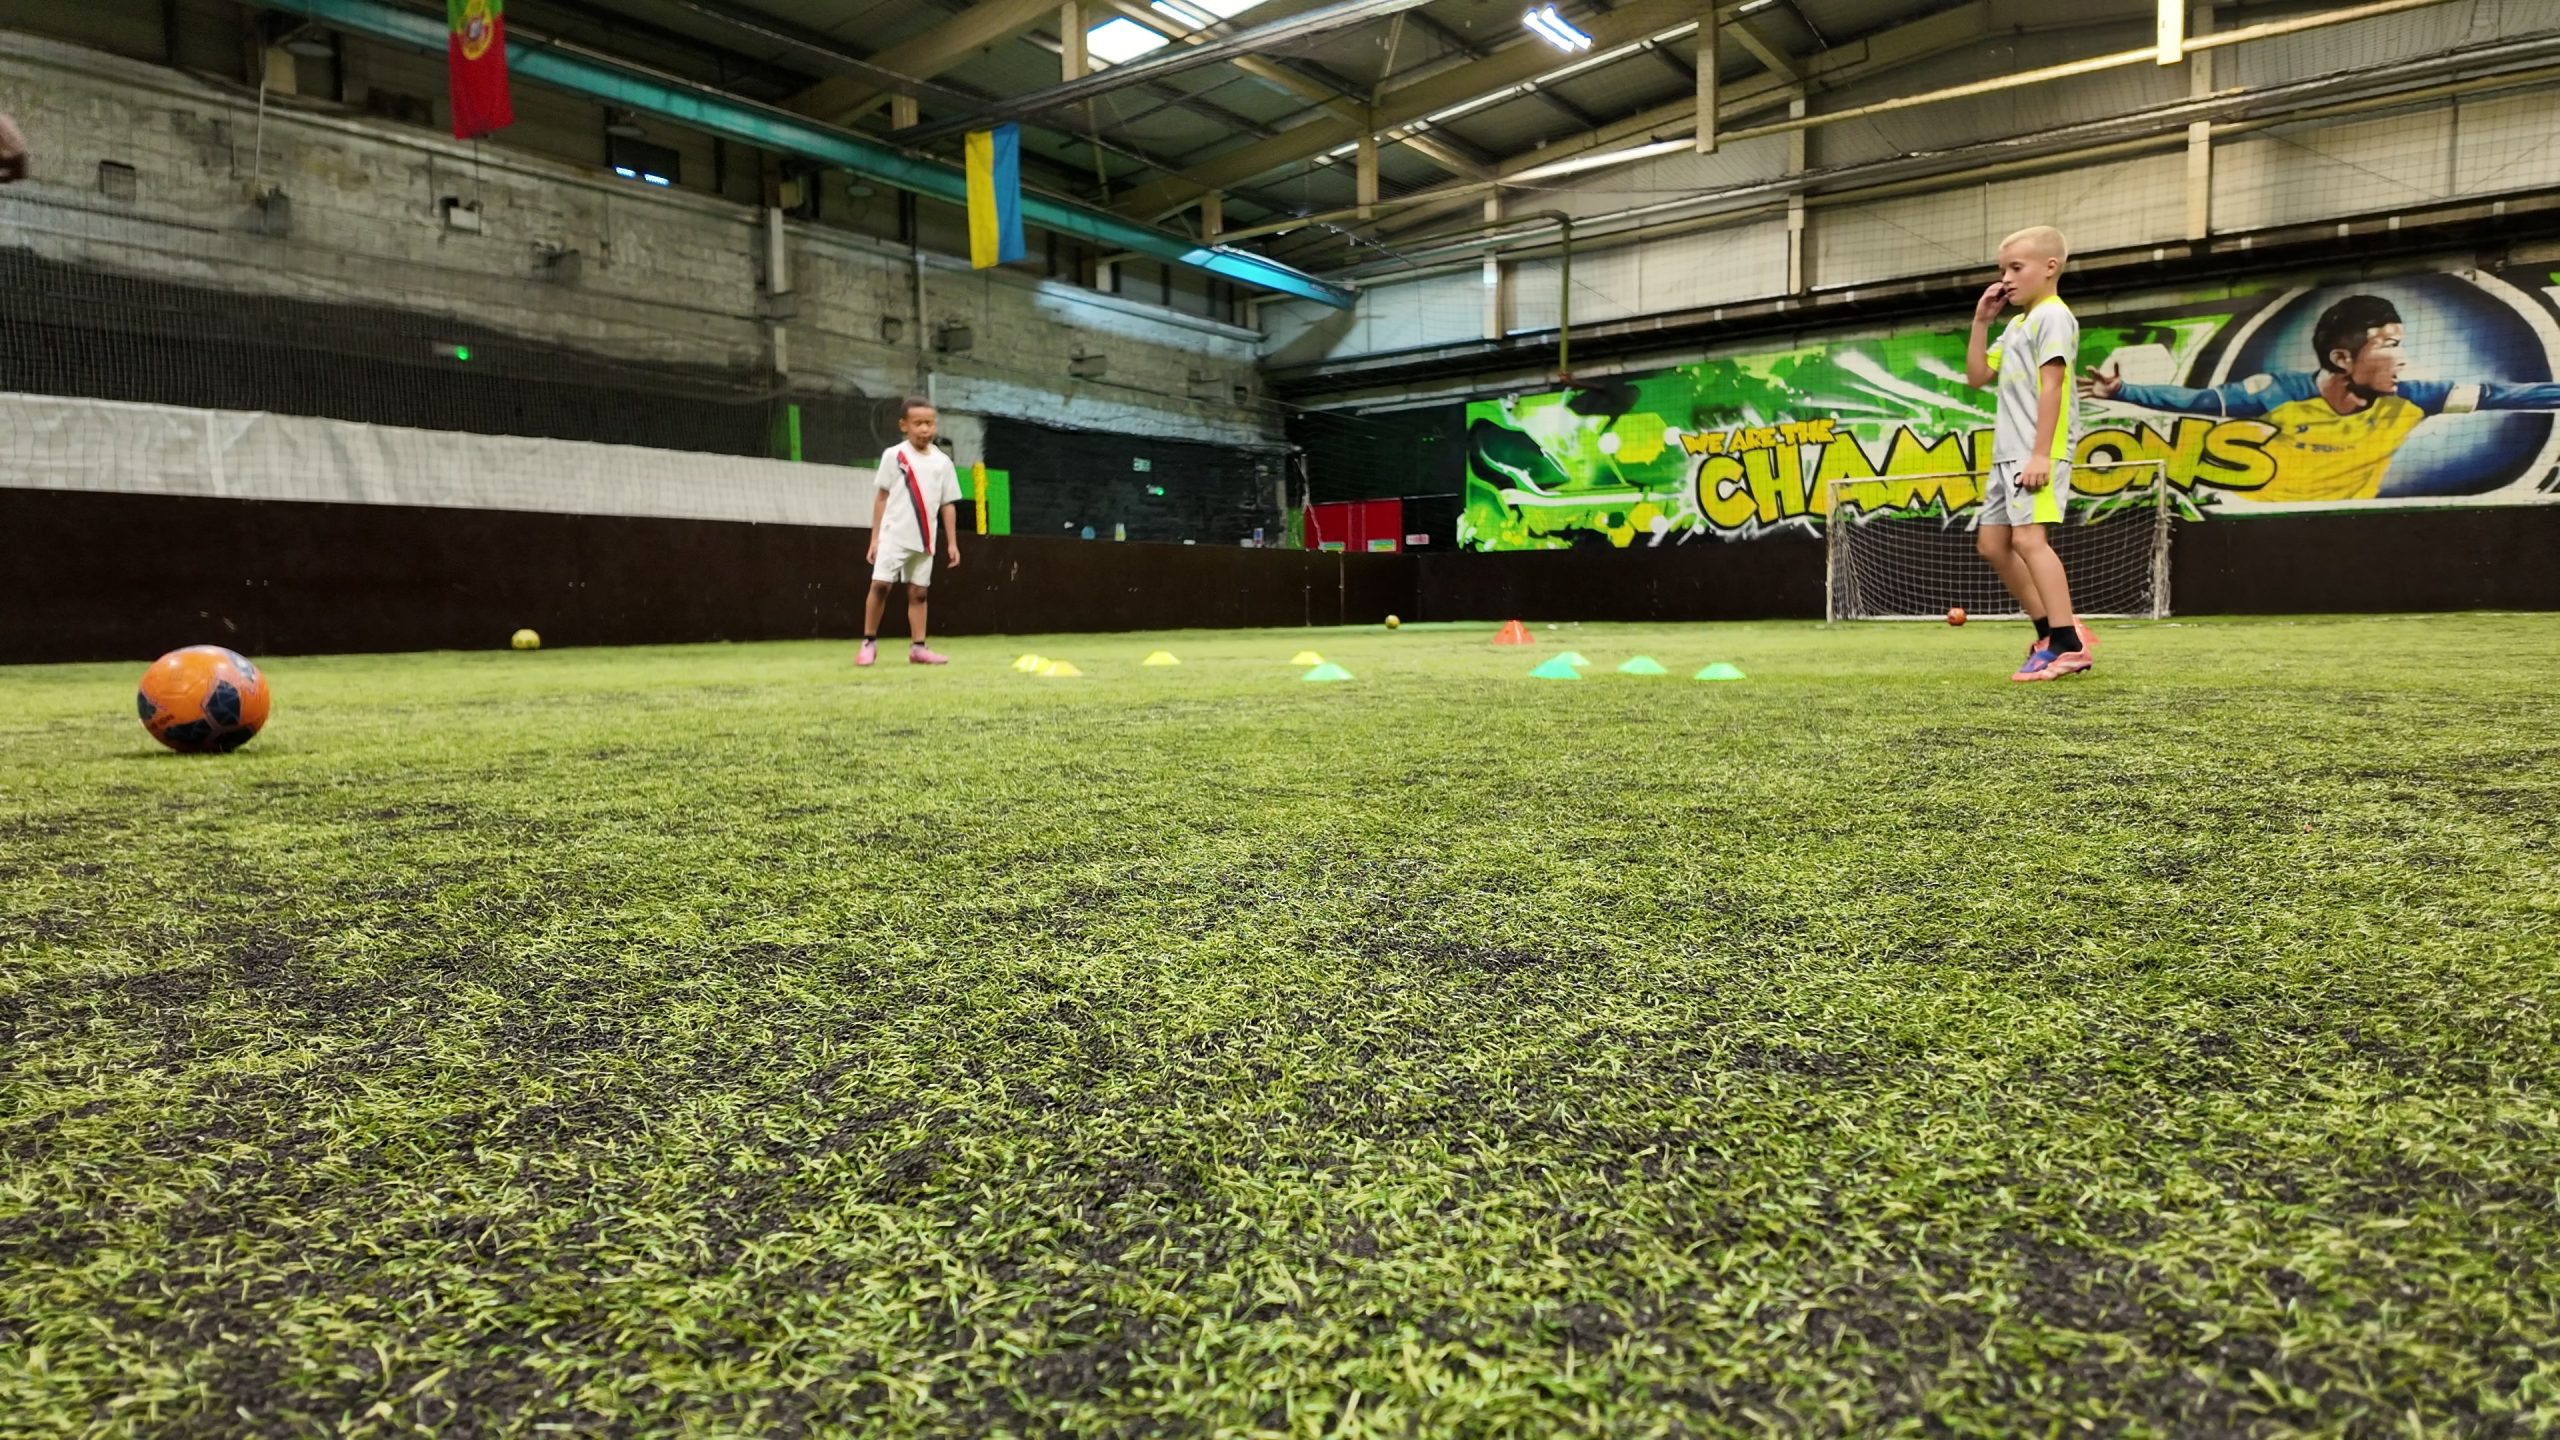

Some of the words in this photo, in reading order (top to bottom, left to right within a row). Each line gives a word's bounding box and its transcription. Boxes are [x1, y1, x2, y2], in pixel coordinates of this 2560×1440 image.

[1680, 433, 1726, 455] WE
[1728, 428, 1778, 452] ARE
[1778, 419, 1837, 446] THE
[1697, 417, 2279, 530] CHAMONS
